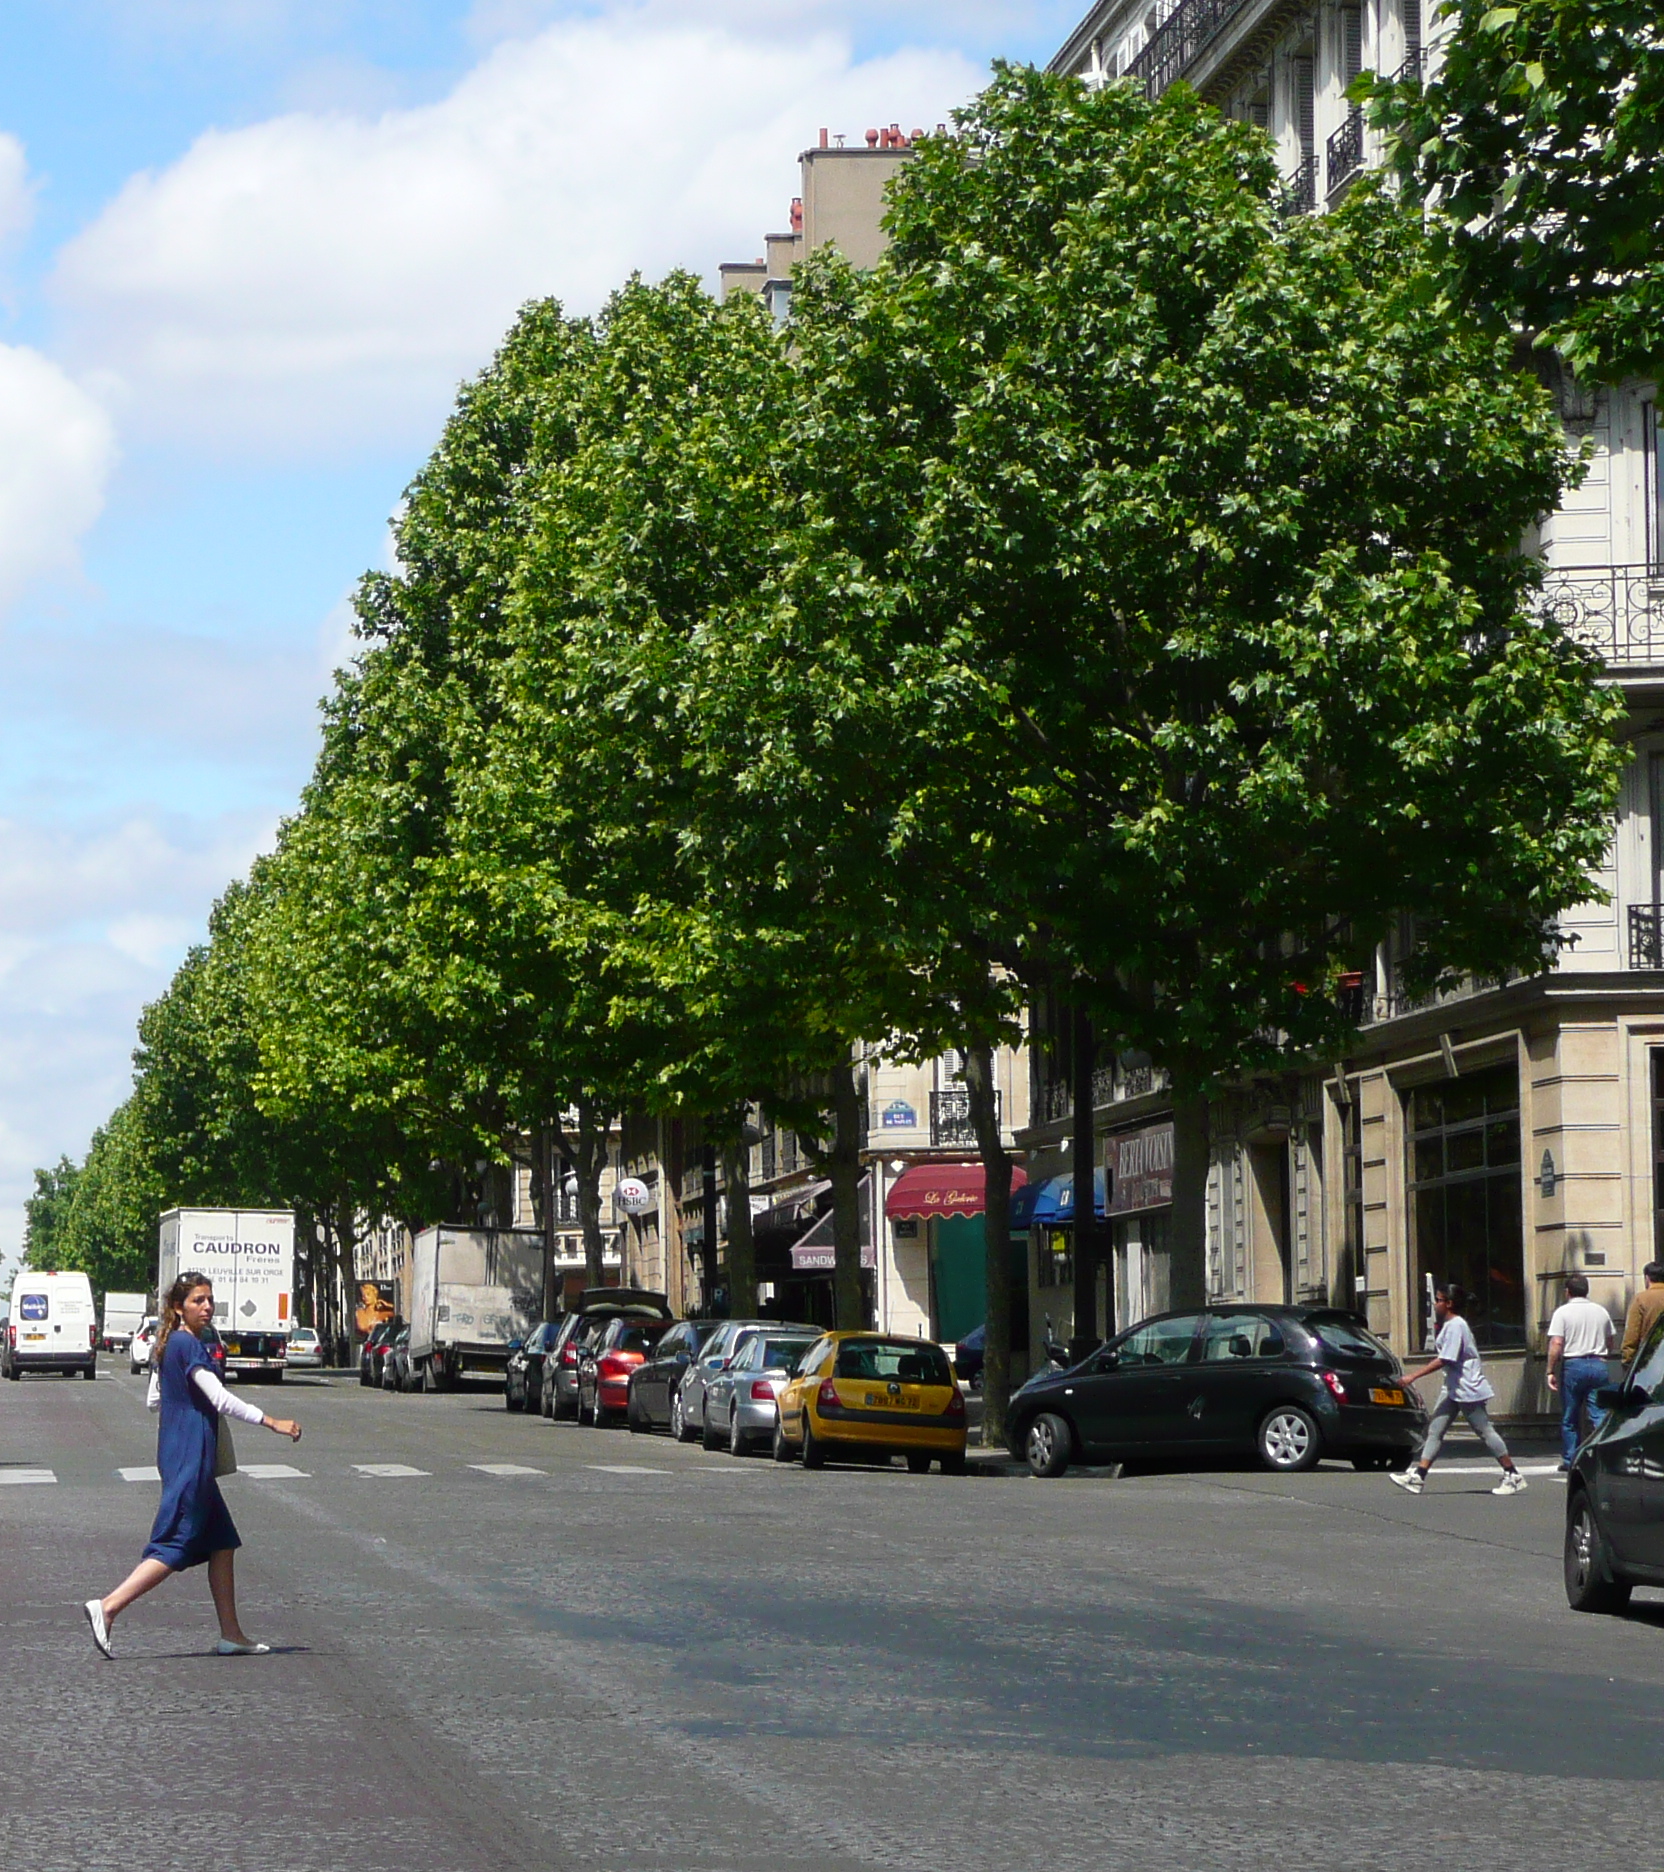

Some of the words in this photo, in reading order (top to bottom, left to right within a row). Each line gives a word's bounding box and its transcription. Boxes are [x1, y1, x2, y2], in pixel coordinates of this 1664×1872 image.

[617, 1196, 647, 1206] HSBC
[193, 1242, 280, 1255] CAUDRON
[799, 1255, 867, 1266] SANDWS
